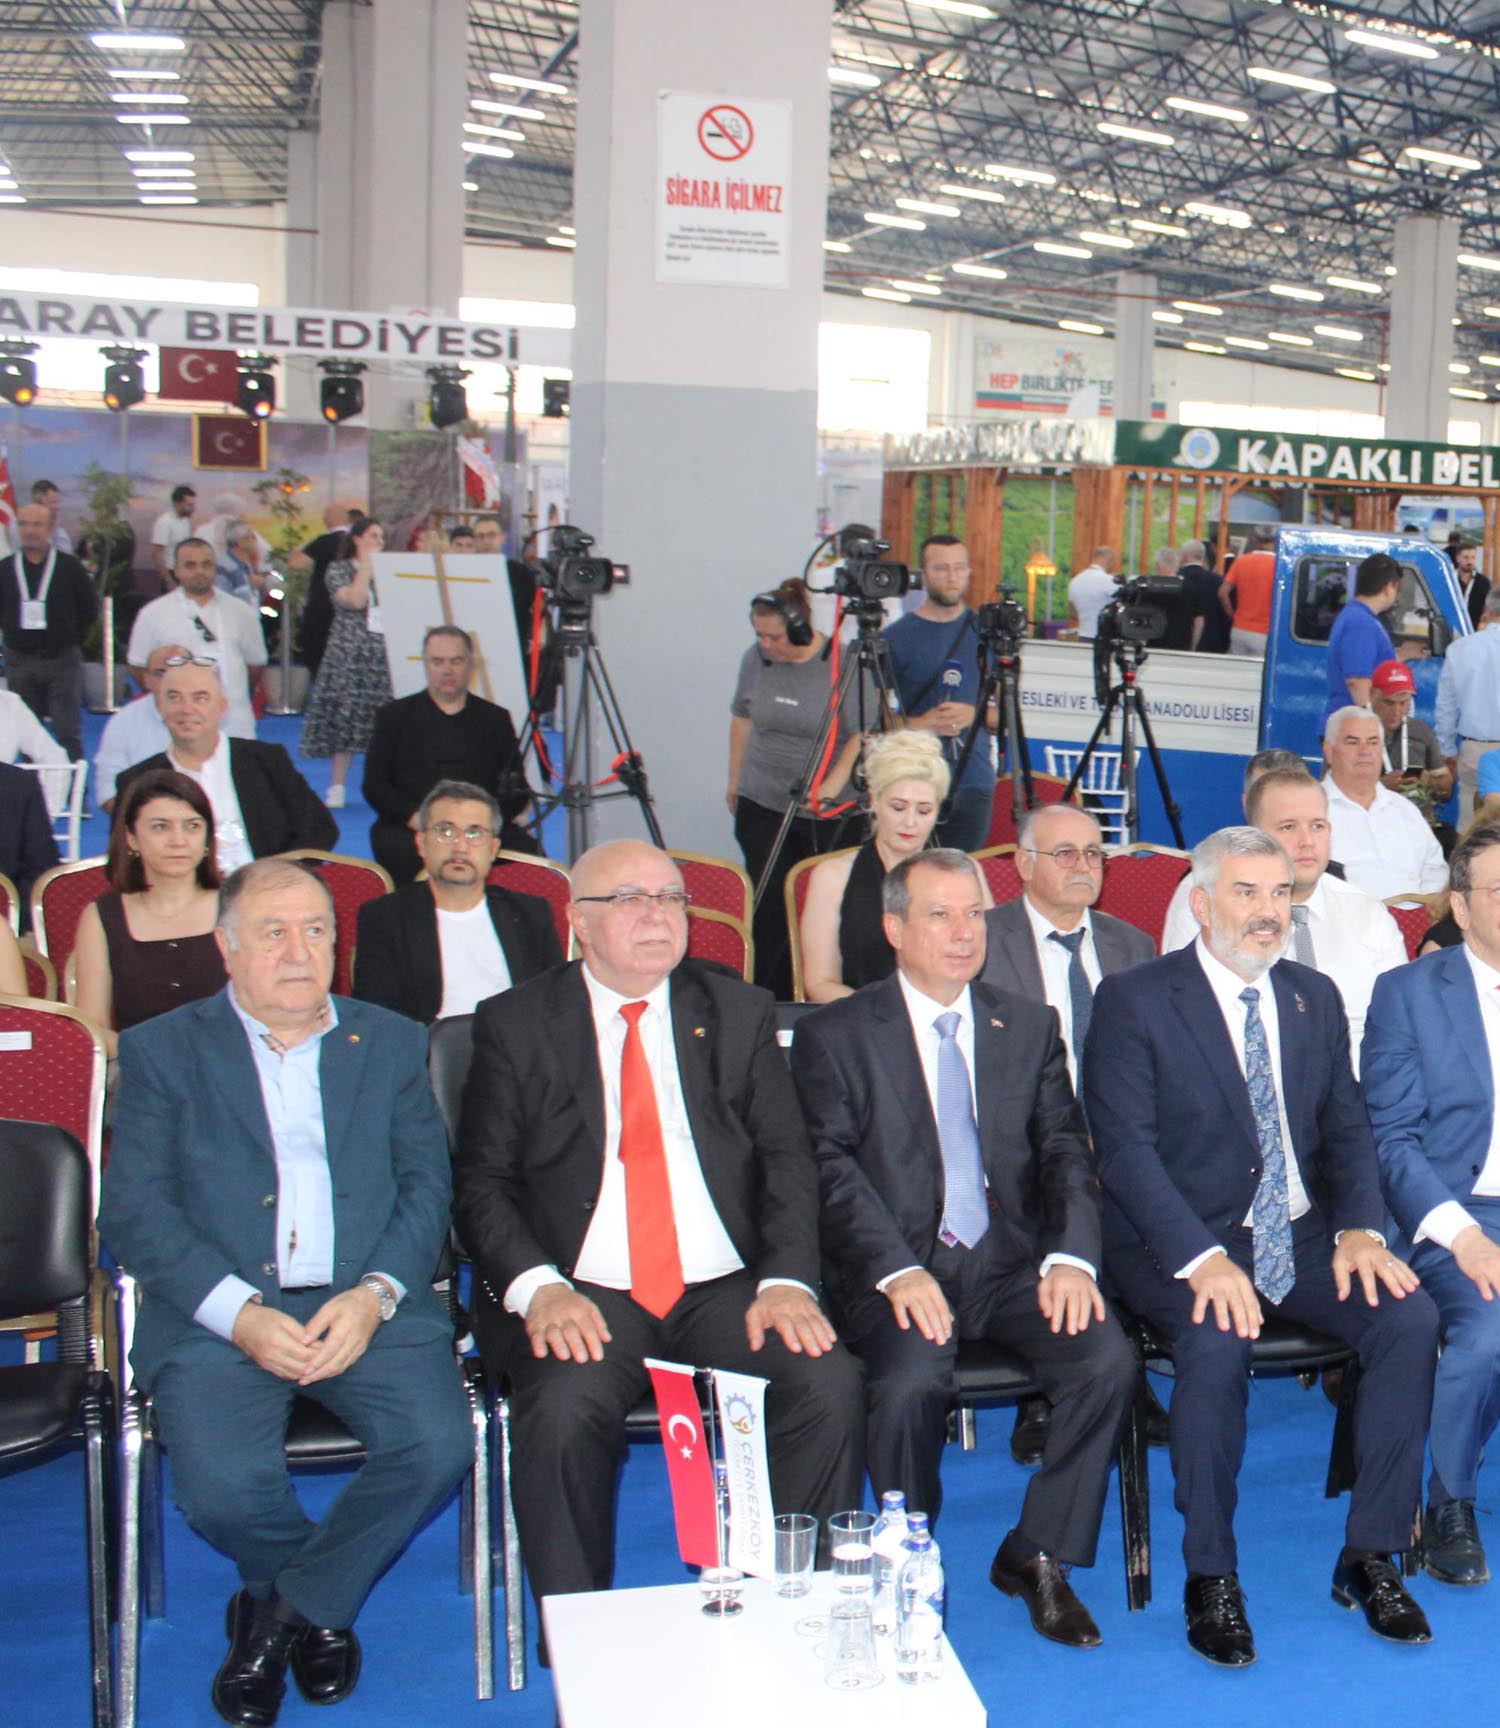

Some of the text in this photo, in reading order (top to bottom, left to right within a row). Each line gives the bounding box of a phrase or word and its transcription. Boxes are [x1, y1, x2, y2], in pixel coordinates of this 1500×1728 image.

[666, 173, 783, 213] SİGARA İÇİLMEZ
[990, 373, 1019, 390] HEP
[1238, 438, 1422, 484] KAPAKLI
[1021, 690, 1067, 708] ESLEKİ
[1072, 695, 1087, 710] VE
[1214, 704, 1254, 722] LİSESİ
